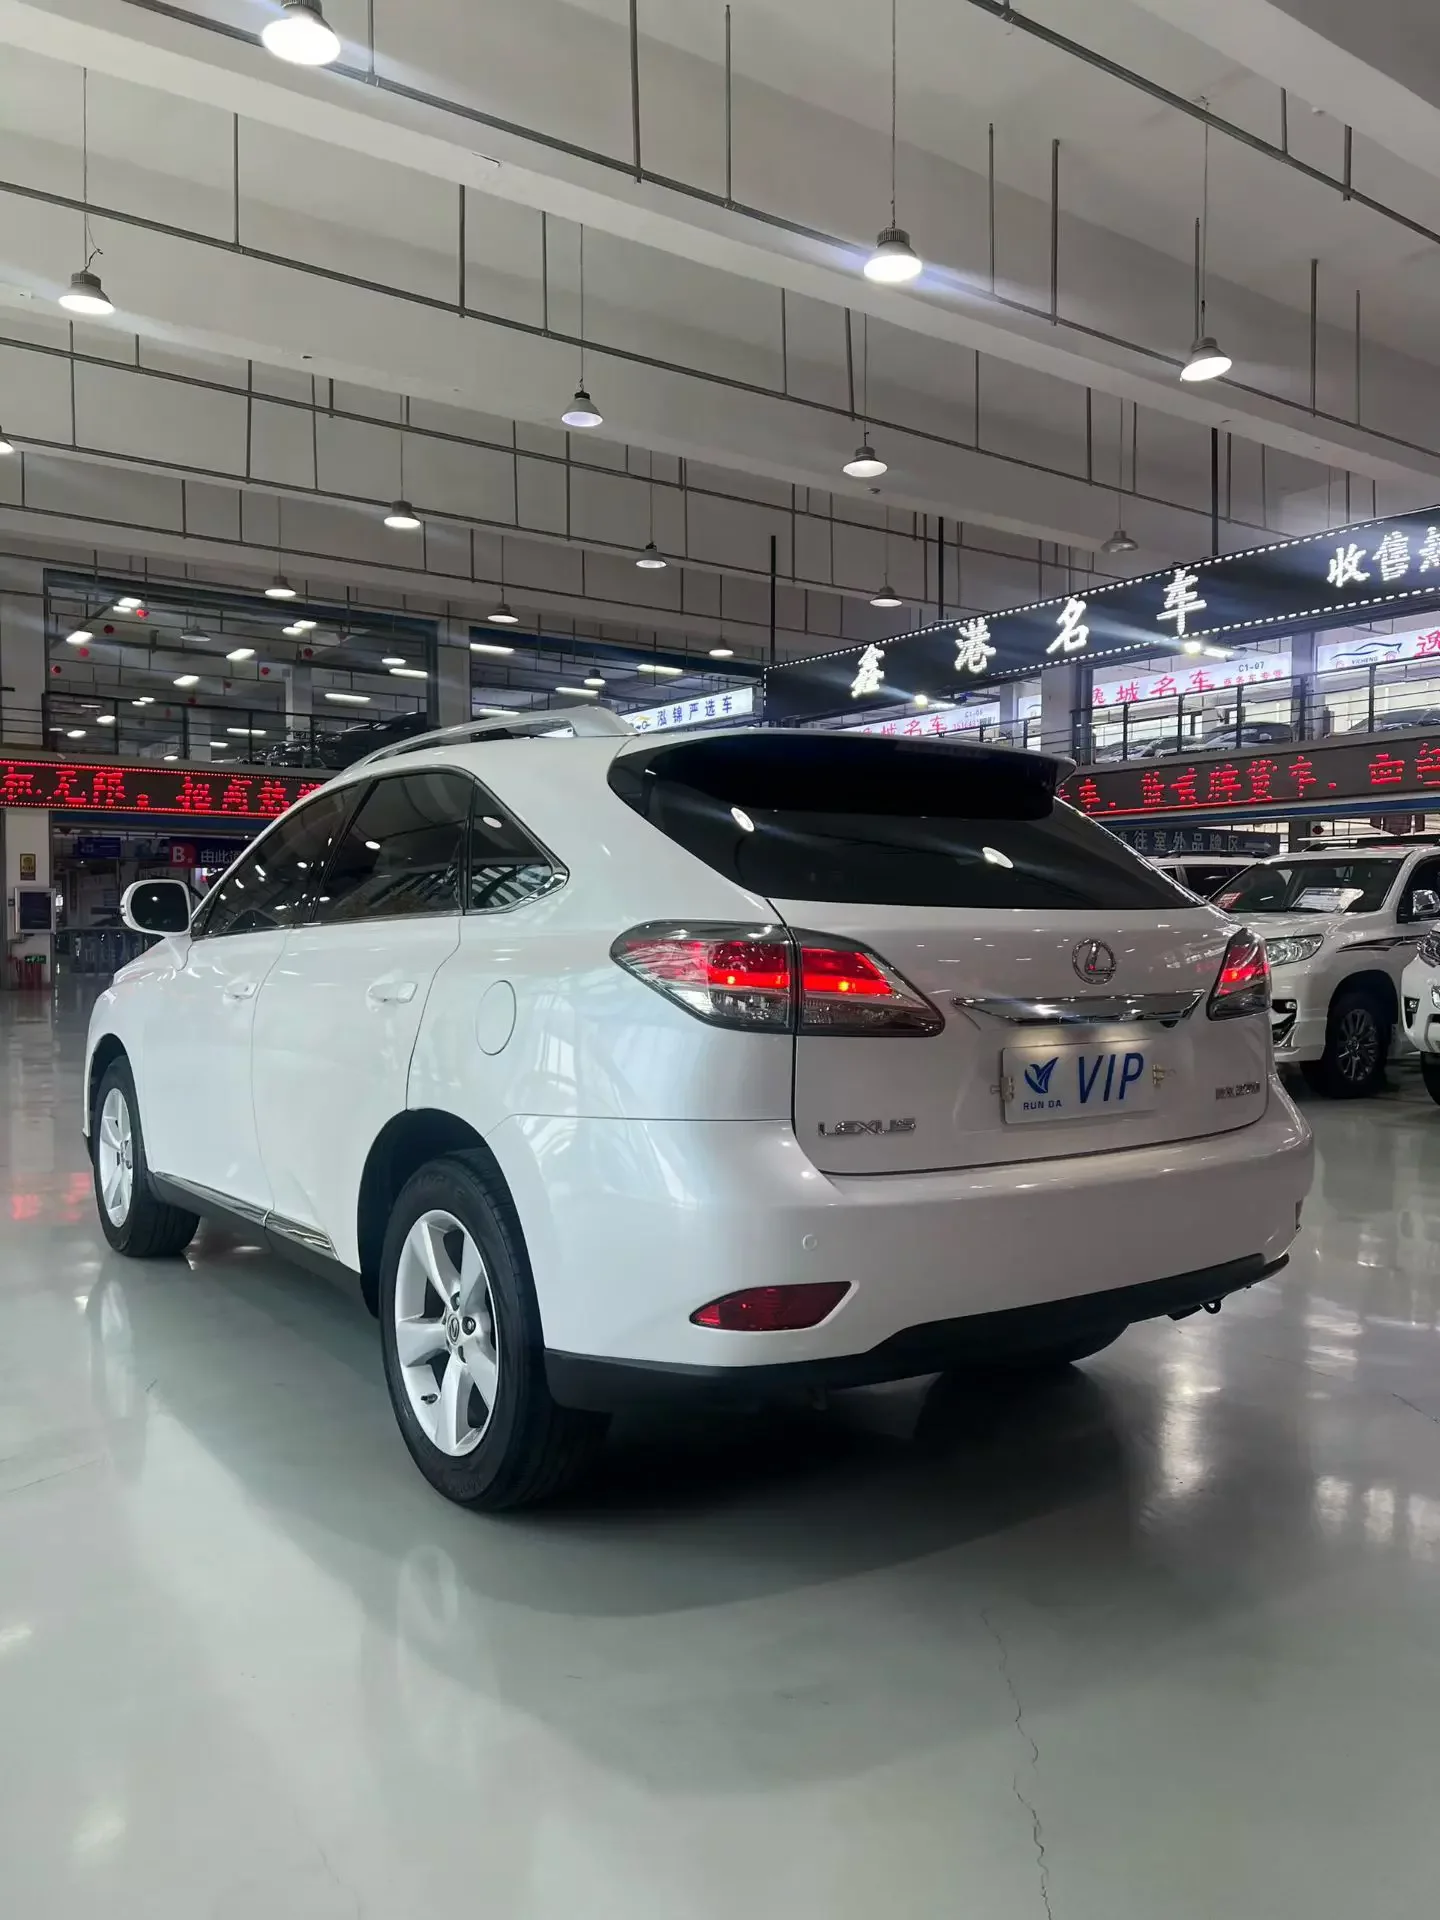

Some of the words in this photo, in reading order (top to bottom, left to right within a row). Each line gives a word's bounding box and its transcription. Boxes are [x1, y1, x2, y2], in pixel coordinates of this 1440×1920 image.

[850, 569, 1208, 698] 鑫港名车
[1238, 661, 1265, 672] C1-07
[657, 695, 733, 726] 泓锦严选车
[1077, 1052, 1144, 1104] VIP
[1023, 1100, 1045, 1111] RUN
[1047, 1099, 1063, 1109] DA
[817, 1117, 916, 1137] LEXUS
